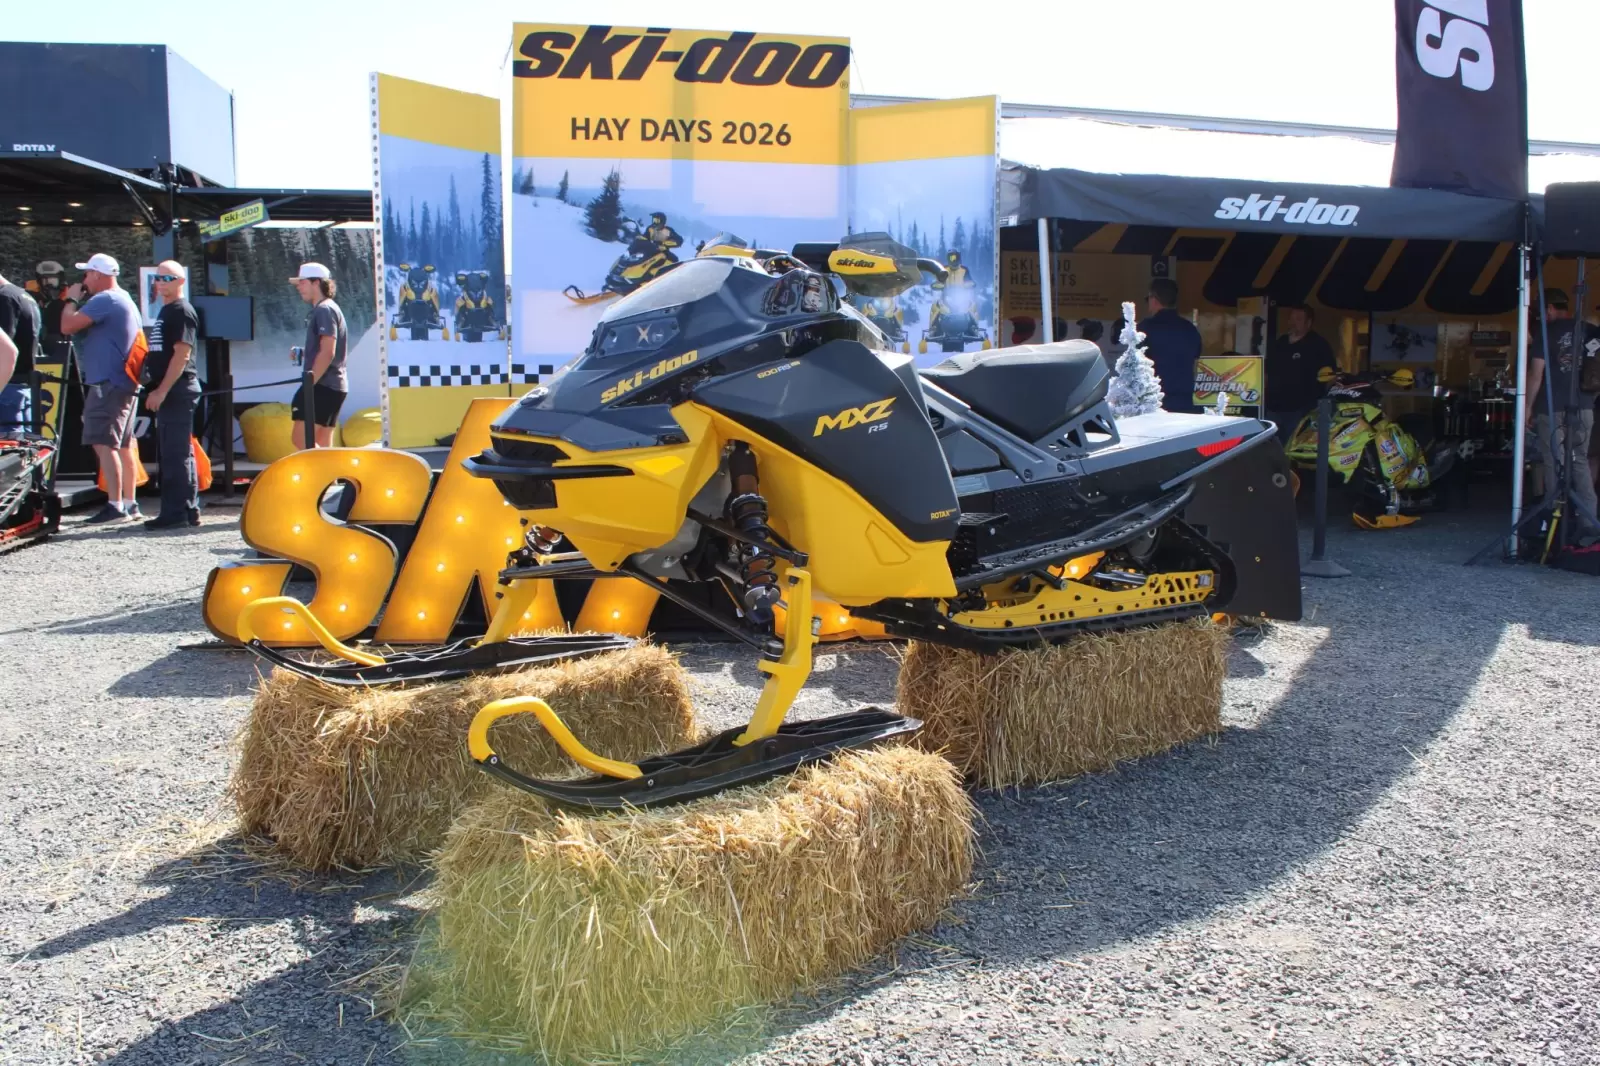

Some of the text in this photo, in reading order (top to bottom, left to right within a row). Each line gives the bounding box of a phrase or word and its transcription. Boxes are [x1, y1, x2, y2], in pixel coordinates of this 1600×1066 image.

[570, 117, 793, 147] HAY DAYS 2026
[1214, 193, 1361, 226] ski-doo
[1010, 272, 1077, 288] HELTS
[601, 349, 698, 404] ski-doo
[1193, 382, 1247, 392] MORGAN
[813, 397, 897, 437] MXZ
[868, 422, 889, 434] RS
[930, 510, 950, 520] ROTAX
